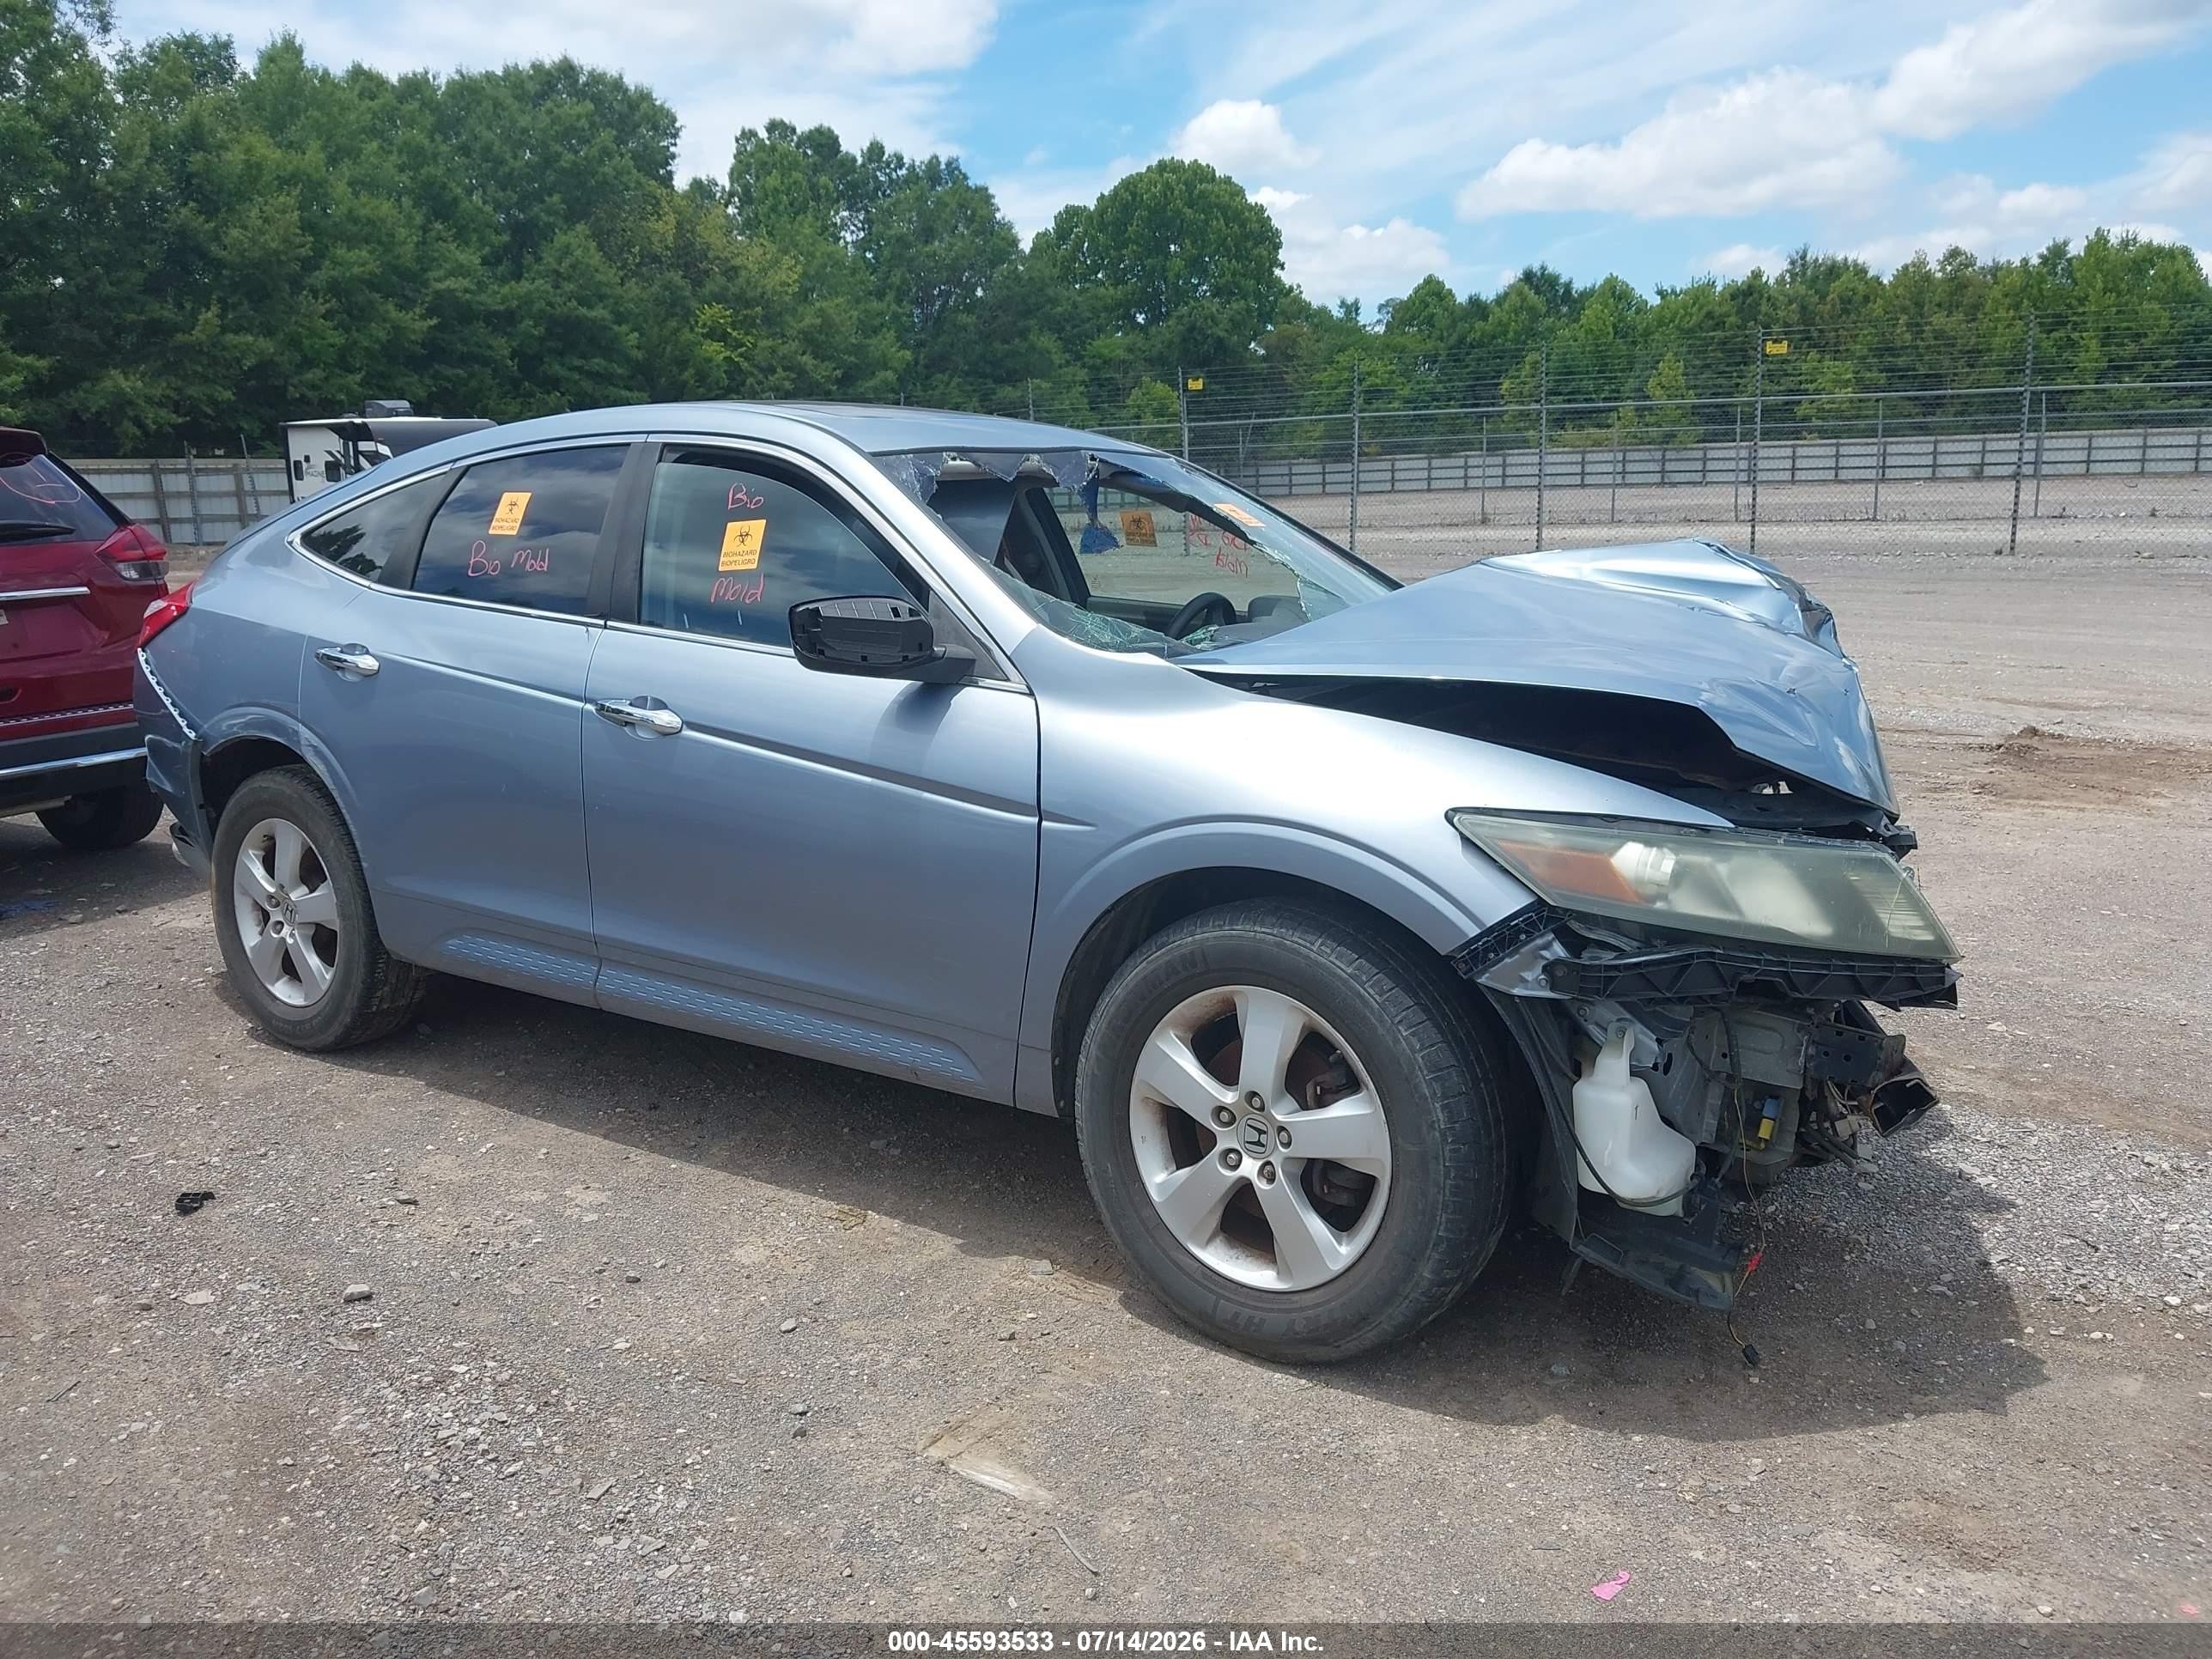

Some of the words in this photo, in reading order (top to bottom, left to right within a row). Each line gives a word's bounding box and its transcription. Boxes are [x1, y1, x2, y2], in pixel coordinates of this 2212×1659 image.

[727, 482, 765, 510] Bio
[467, 539, 501, 577] Bio
[510, 547, 550, 572] Mold
[720, 558, 757, 567] BIOPELIGRO
[722, 550, 757, 558] BIOHAZARD
[710, 572, 765, 604] Mold
